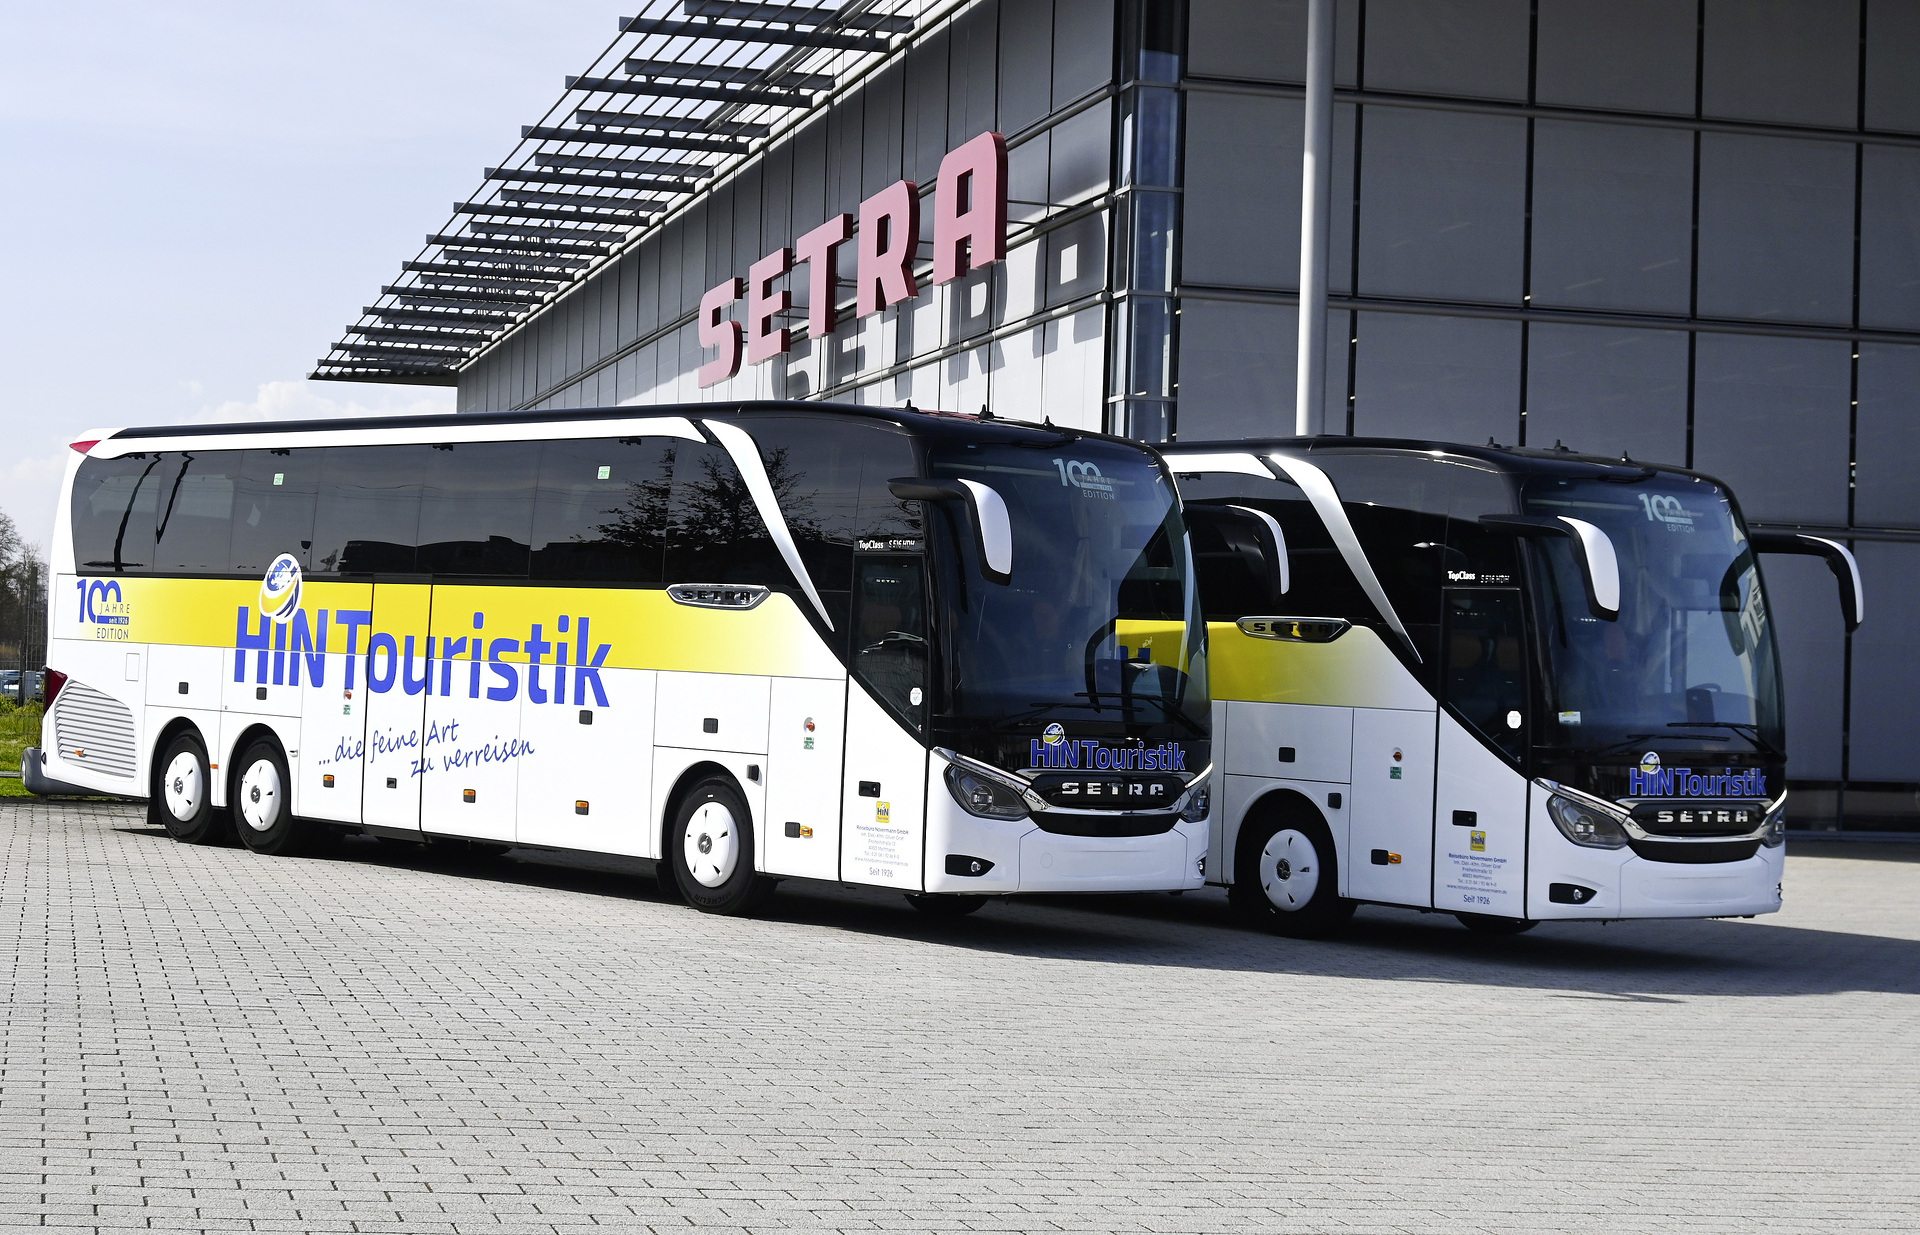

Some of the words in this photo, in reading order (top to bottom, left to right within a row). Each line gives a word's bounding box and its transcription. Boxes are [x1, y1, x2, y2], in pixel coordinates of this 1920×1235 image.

[698, 131, 1008, 388] SETRA
[1053, 458, 1101, 487] 100
[1083, 490, 1114, 500] EDITION
[1638, 493, 1682, 521] 100
[1667, 524, 1695, 534] EDITION
[859, 540, 884, 551] TopClass
[1448, 571, 1476, 581] TopClass
[77, 579, 122, 623] 100
[682, 590, 752, 601] SETRA
[100, 603, 131, 615] JAHRE
[97, 628, 129, 640] EDITION
[336, 610, 612, 707] Touristik
[370, 727, 419, 763] feine
[426, 718, 460, 748] Art
[411, 758, 435, 778] zu
[443, 735, 536, 772] verreisen
[1081, 740, 1186, 771] Touristik
[1675, 767, 1767, 797] Touristik
[1061, 782, 1164, 796] SETRA
[1657, 810, 1748, 823] SETRA
[869, 867, 880, 876] Seit
[881, 869, 893, 878] 1926
[1463, 894, 1475, 903] Seit
[1477, 896, 1490, 905] 1926
